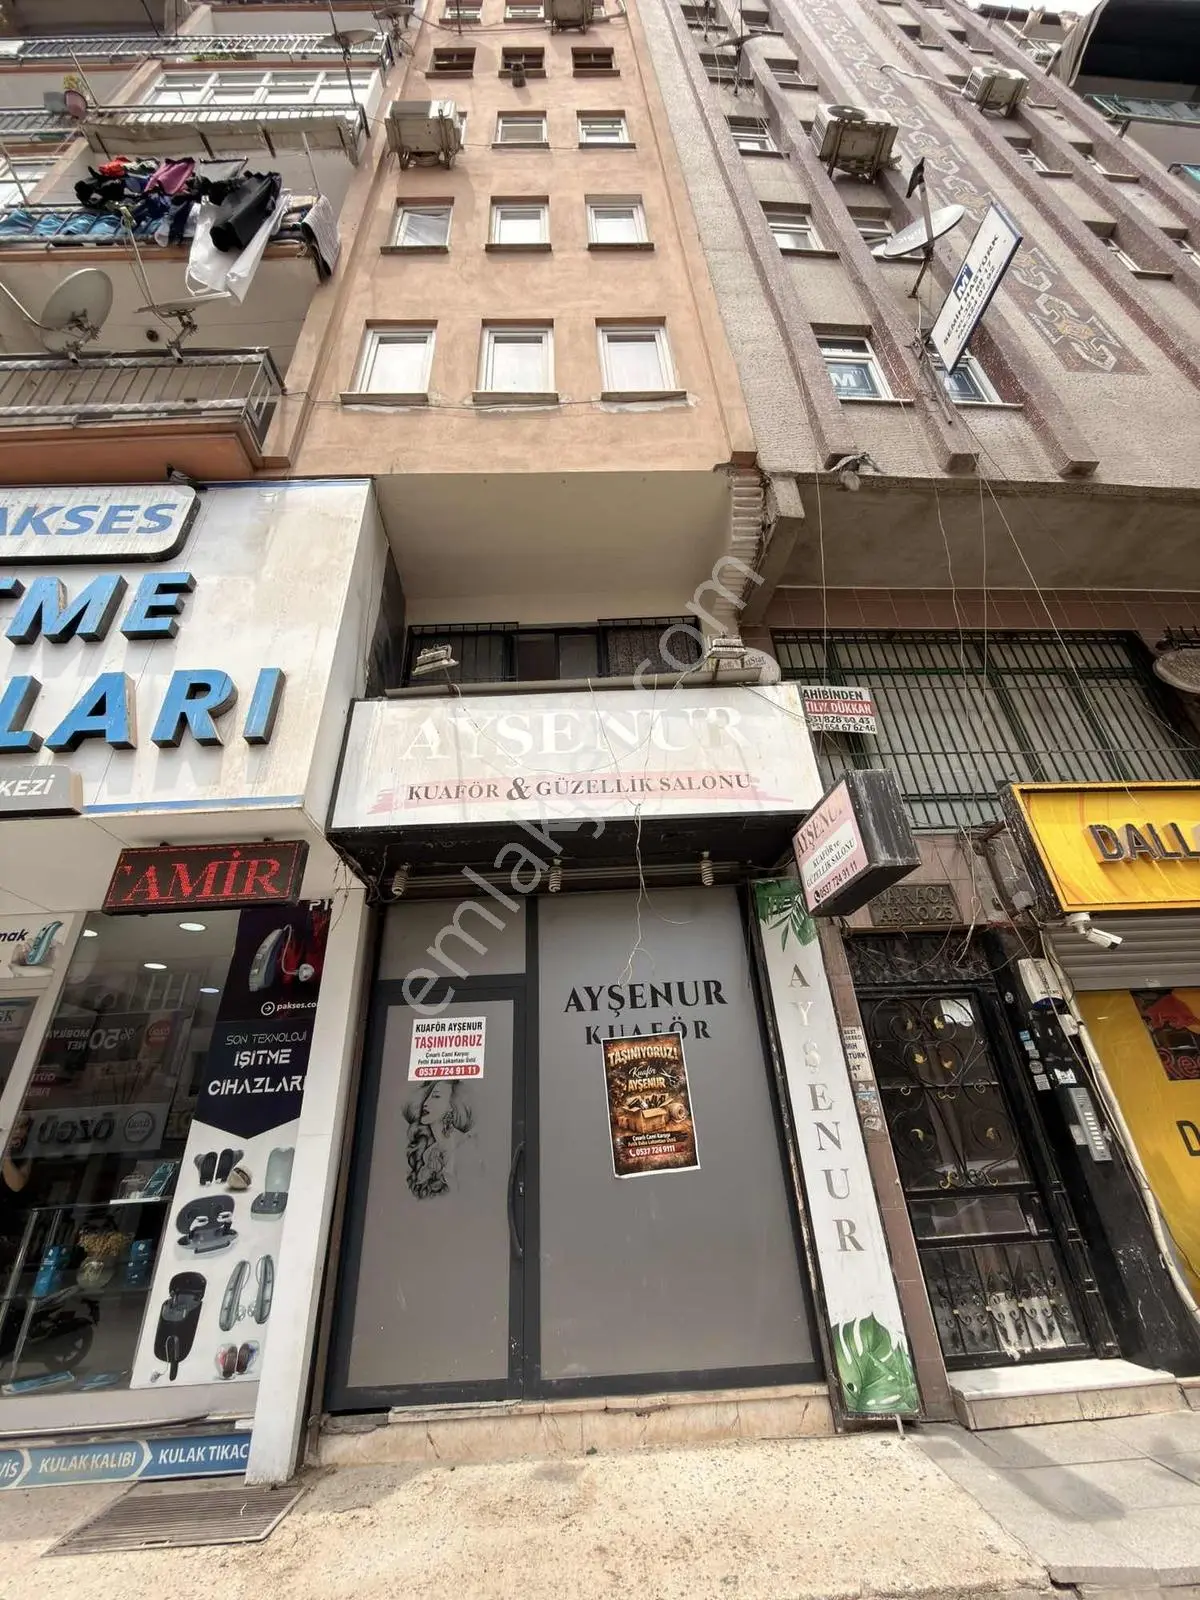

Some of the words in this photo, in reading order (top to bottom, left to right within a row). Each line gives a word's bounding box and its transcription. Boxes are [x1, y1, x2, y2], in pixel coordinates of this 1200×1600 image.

[0, 504, 178, 535] KSES
[0, 572, 197, 644] ME
[831, 701, 872, 714] DÜKKAN
[824, 715, 842, 723] 828
[842, 723, 851, 731] 67
[408, 781, 500, 801] KUAFÖR
[506, 776, 531, 801] &
[536, 775, 653, 796] GÜZELLİK
[659, 774, 751, 792] SALONU
[797, 796, 842, 858] AYŞENU
[119, 851, 281, 901] AMİR
[563, 980, 728, 1017] AYŞENUR
[416, 1021, 446, 1033] KUAFÖR
[448, 1021, 483, 1033] AYŞENUR
[225, 1034, 248, 1045] SON
[414, 1034, 483, 1052] TAŞINIYORUZ
[607, 1045, 679, 1067] TAŞINIYORUZ!
[419, 1068, 438, 1077] 0537
[440, 1067, 454, 1075] 724
[468, 1066, 477, 1074] 11
[628, 1076, 667, 1092] AYŞENUR
[788, 963, 866, 1252] AYŞENUR
[636, 1148, 651, 1156] 0537
[39, 1454, 89, 1473] KULAK
[90, 1451, 137, 1472] KALIBI
[158, 1446, 207, 1465] KULAK
